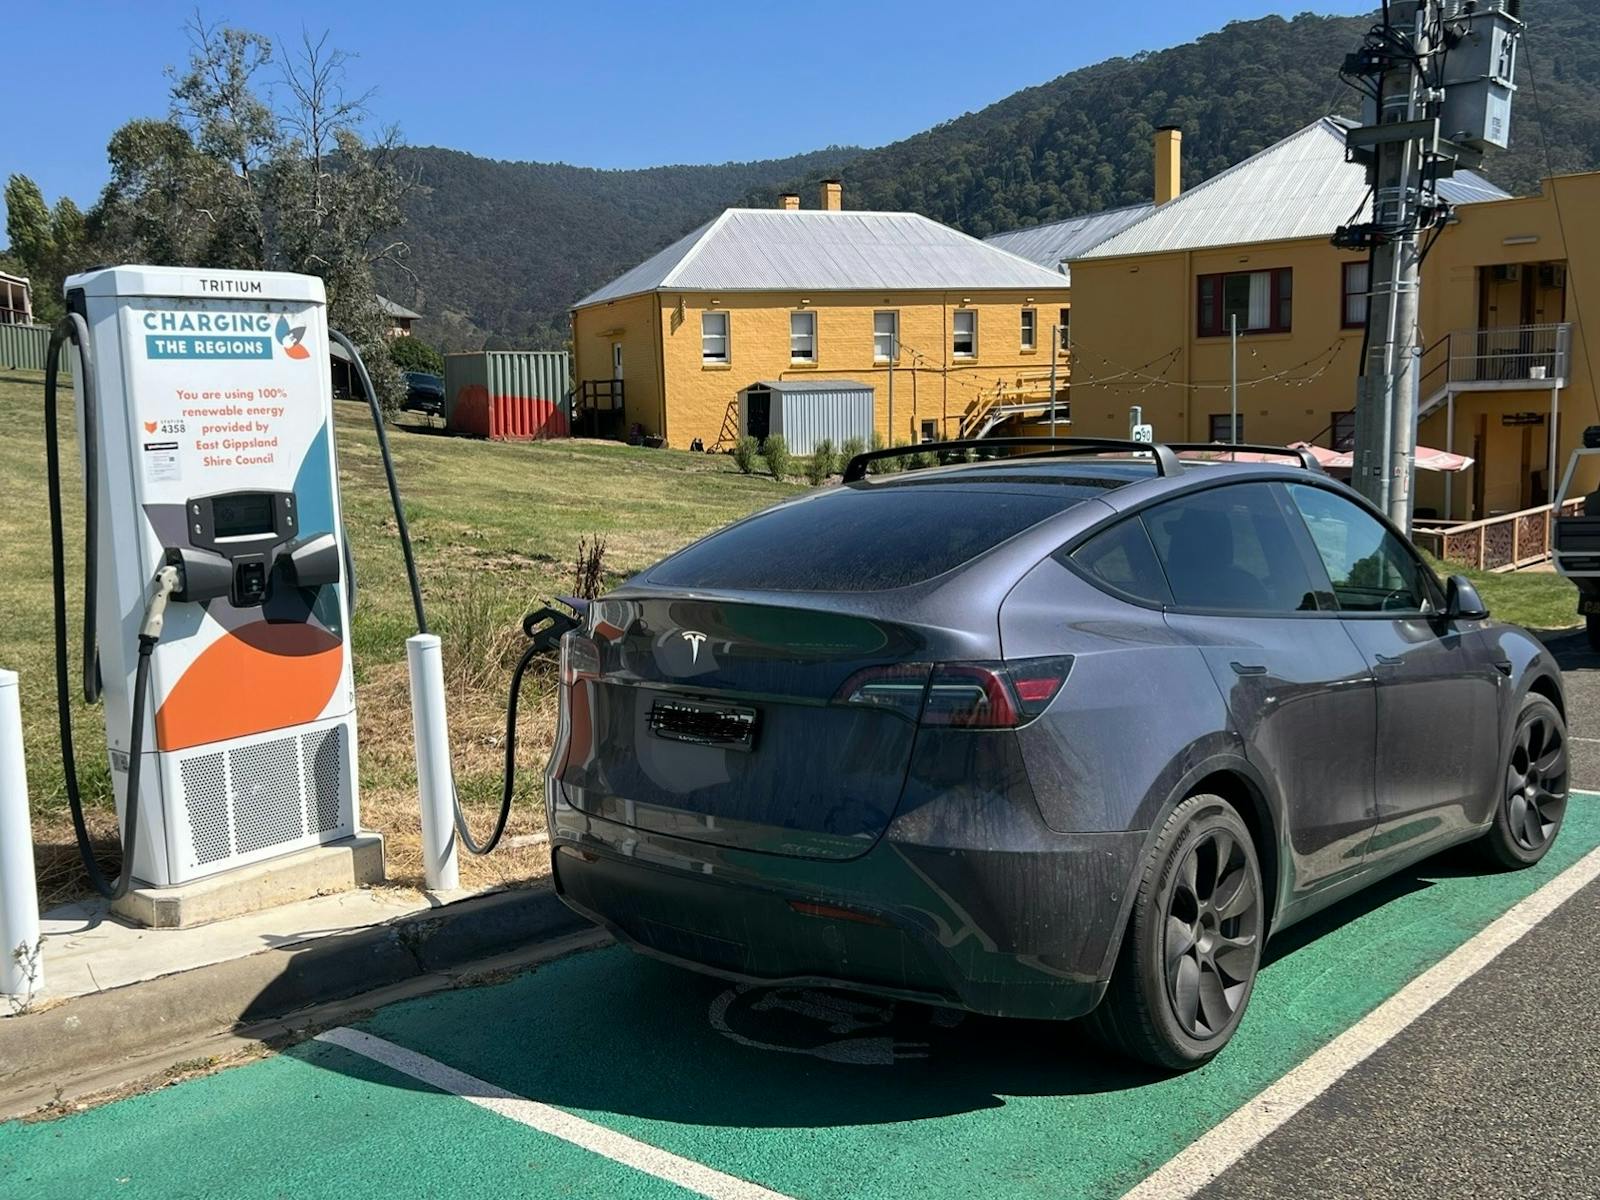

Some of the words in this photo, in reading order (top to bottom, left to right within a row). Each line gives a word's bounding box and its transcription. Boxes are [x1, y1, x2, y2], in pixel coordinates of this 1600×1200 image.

[200, 279, 262, 293] TRITIUM
[143, 312, 271, 332] CHARGING
[155, 340, 187, 354] THE
[195, 341, 263, 354] REGIONS
[176, 390, 198, 400] You
[202, 391, 221, 400] are
[225, 389, 254, 401] using
[258, 388, 287, 399] 100%
[182, 405, 243, 417] renewable
[247, 406, 284, 417] energy
[161, 424, 186, 434] 4358
[202, 421, 252, 435] provided
[255, 421, 269, 433] by
[196, 439, 219, 450] East
[222, 437, 278, 451] Gippsland
[203, 455, 232, 467] Shire
[235, 453, 274, 465] Council
